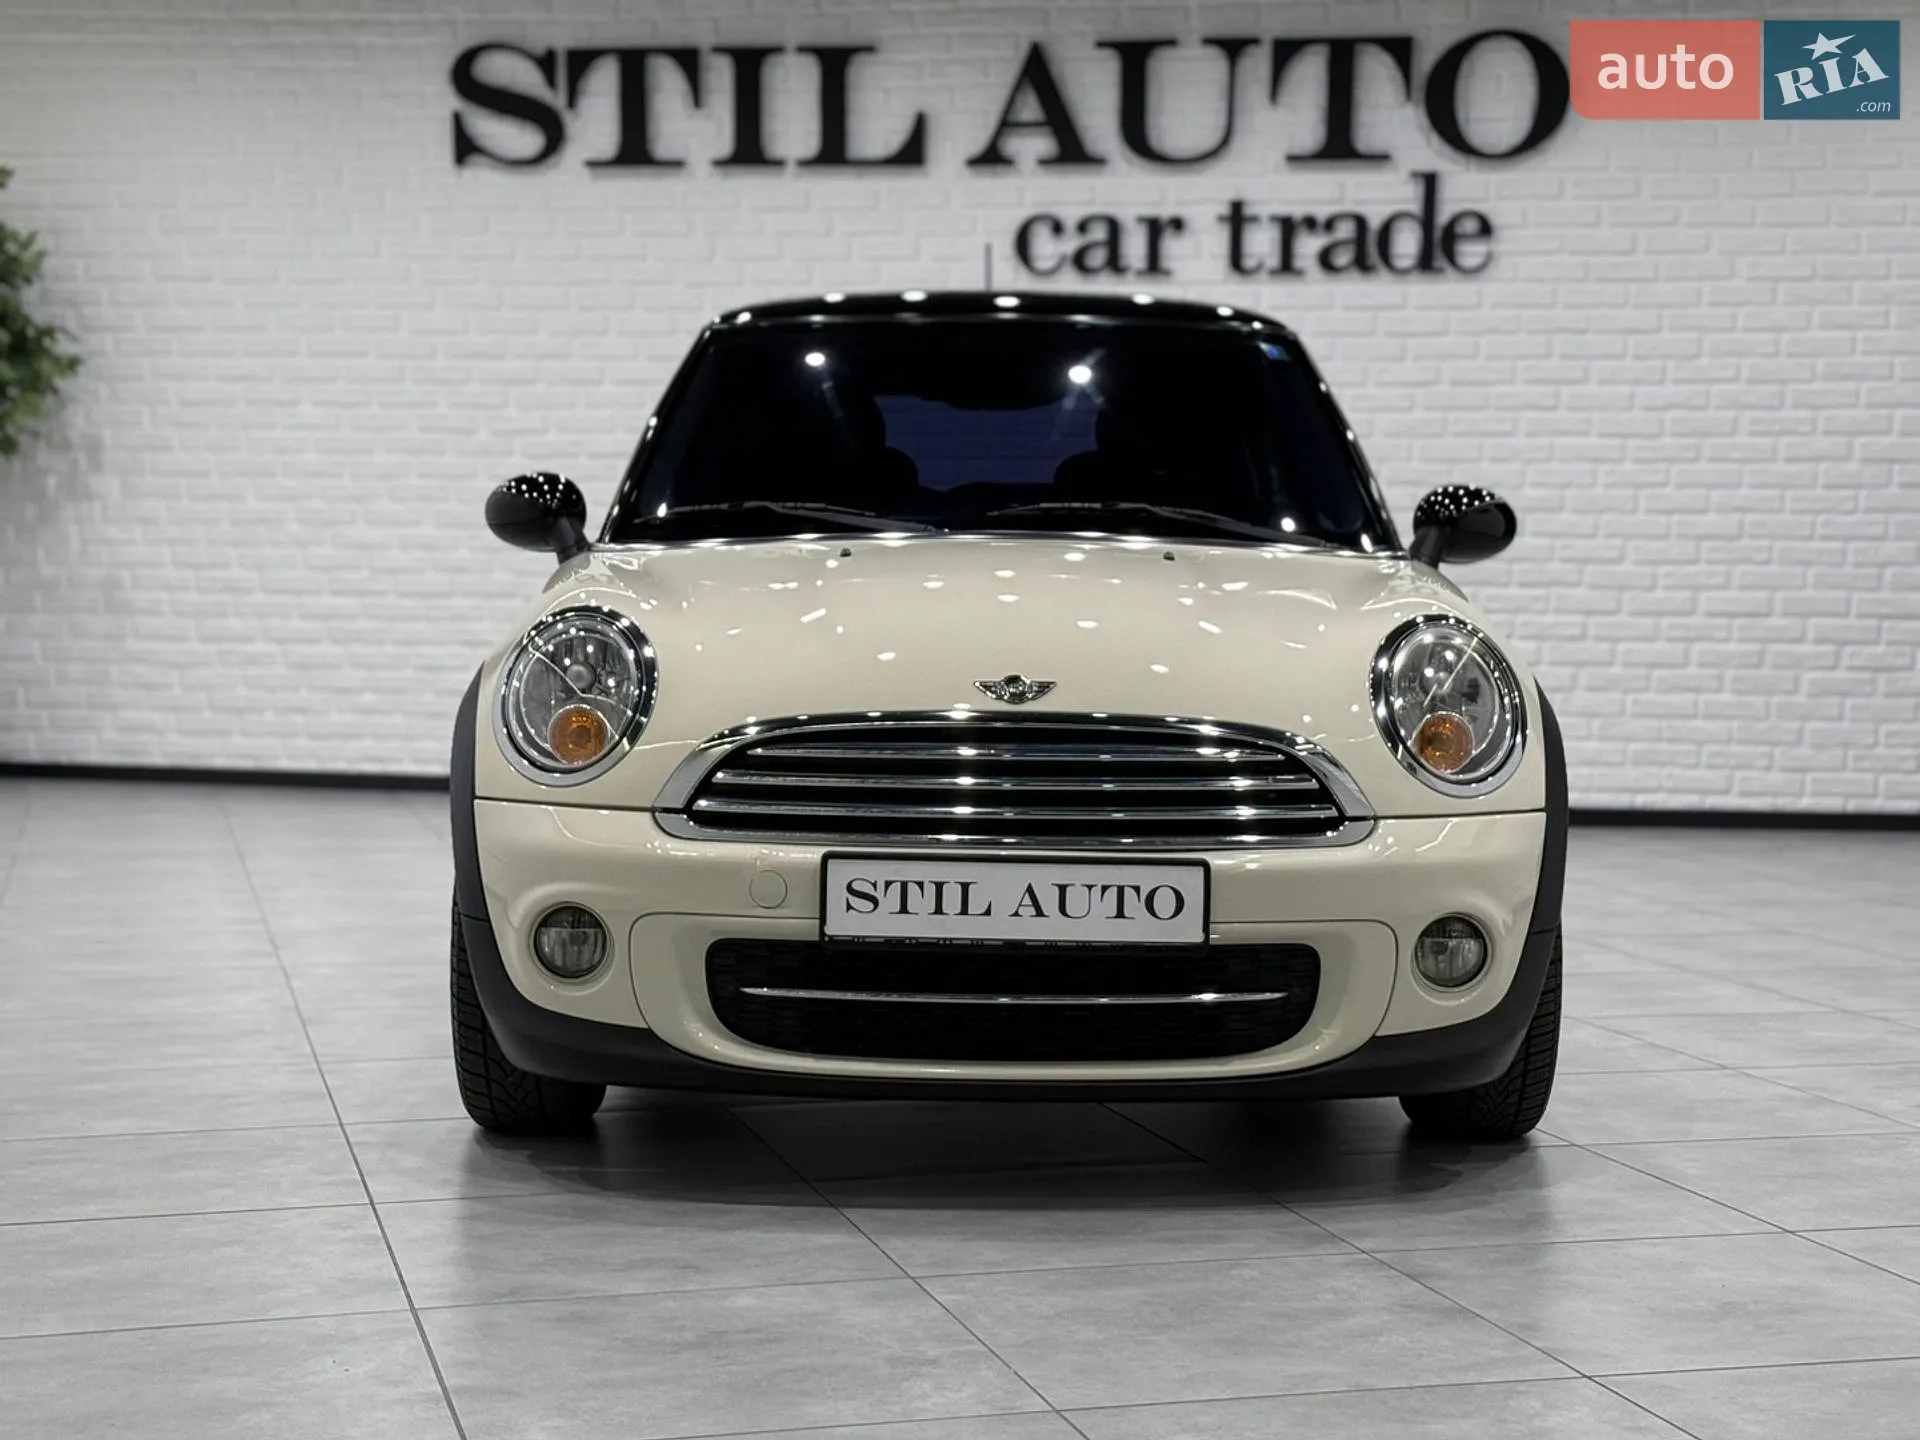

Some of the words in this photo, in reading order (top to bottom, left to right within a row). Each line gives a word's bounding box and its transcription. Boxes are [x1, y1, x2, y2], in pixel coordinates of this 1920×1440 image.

[451, 43, 927, 168] STIL
[966, 29, 1570, 166] AUTO
[1015, 212, 1184, 276] car
[1219, 172, 1494, 276] trade
[845, 877, 992, 917] STIL
[1008, 882, 1185, 921] AUTO
